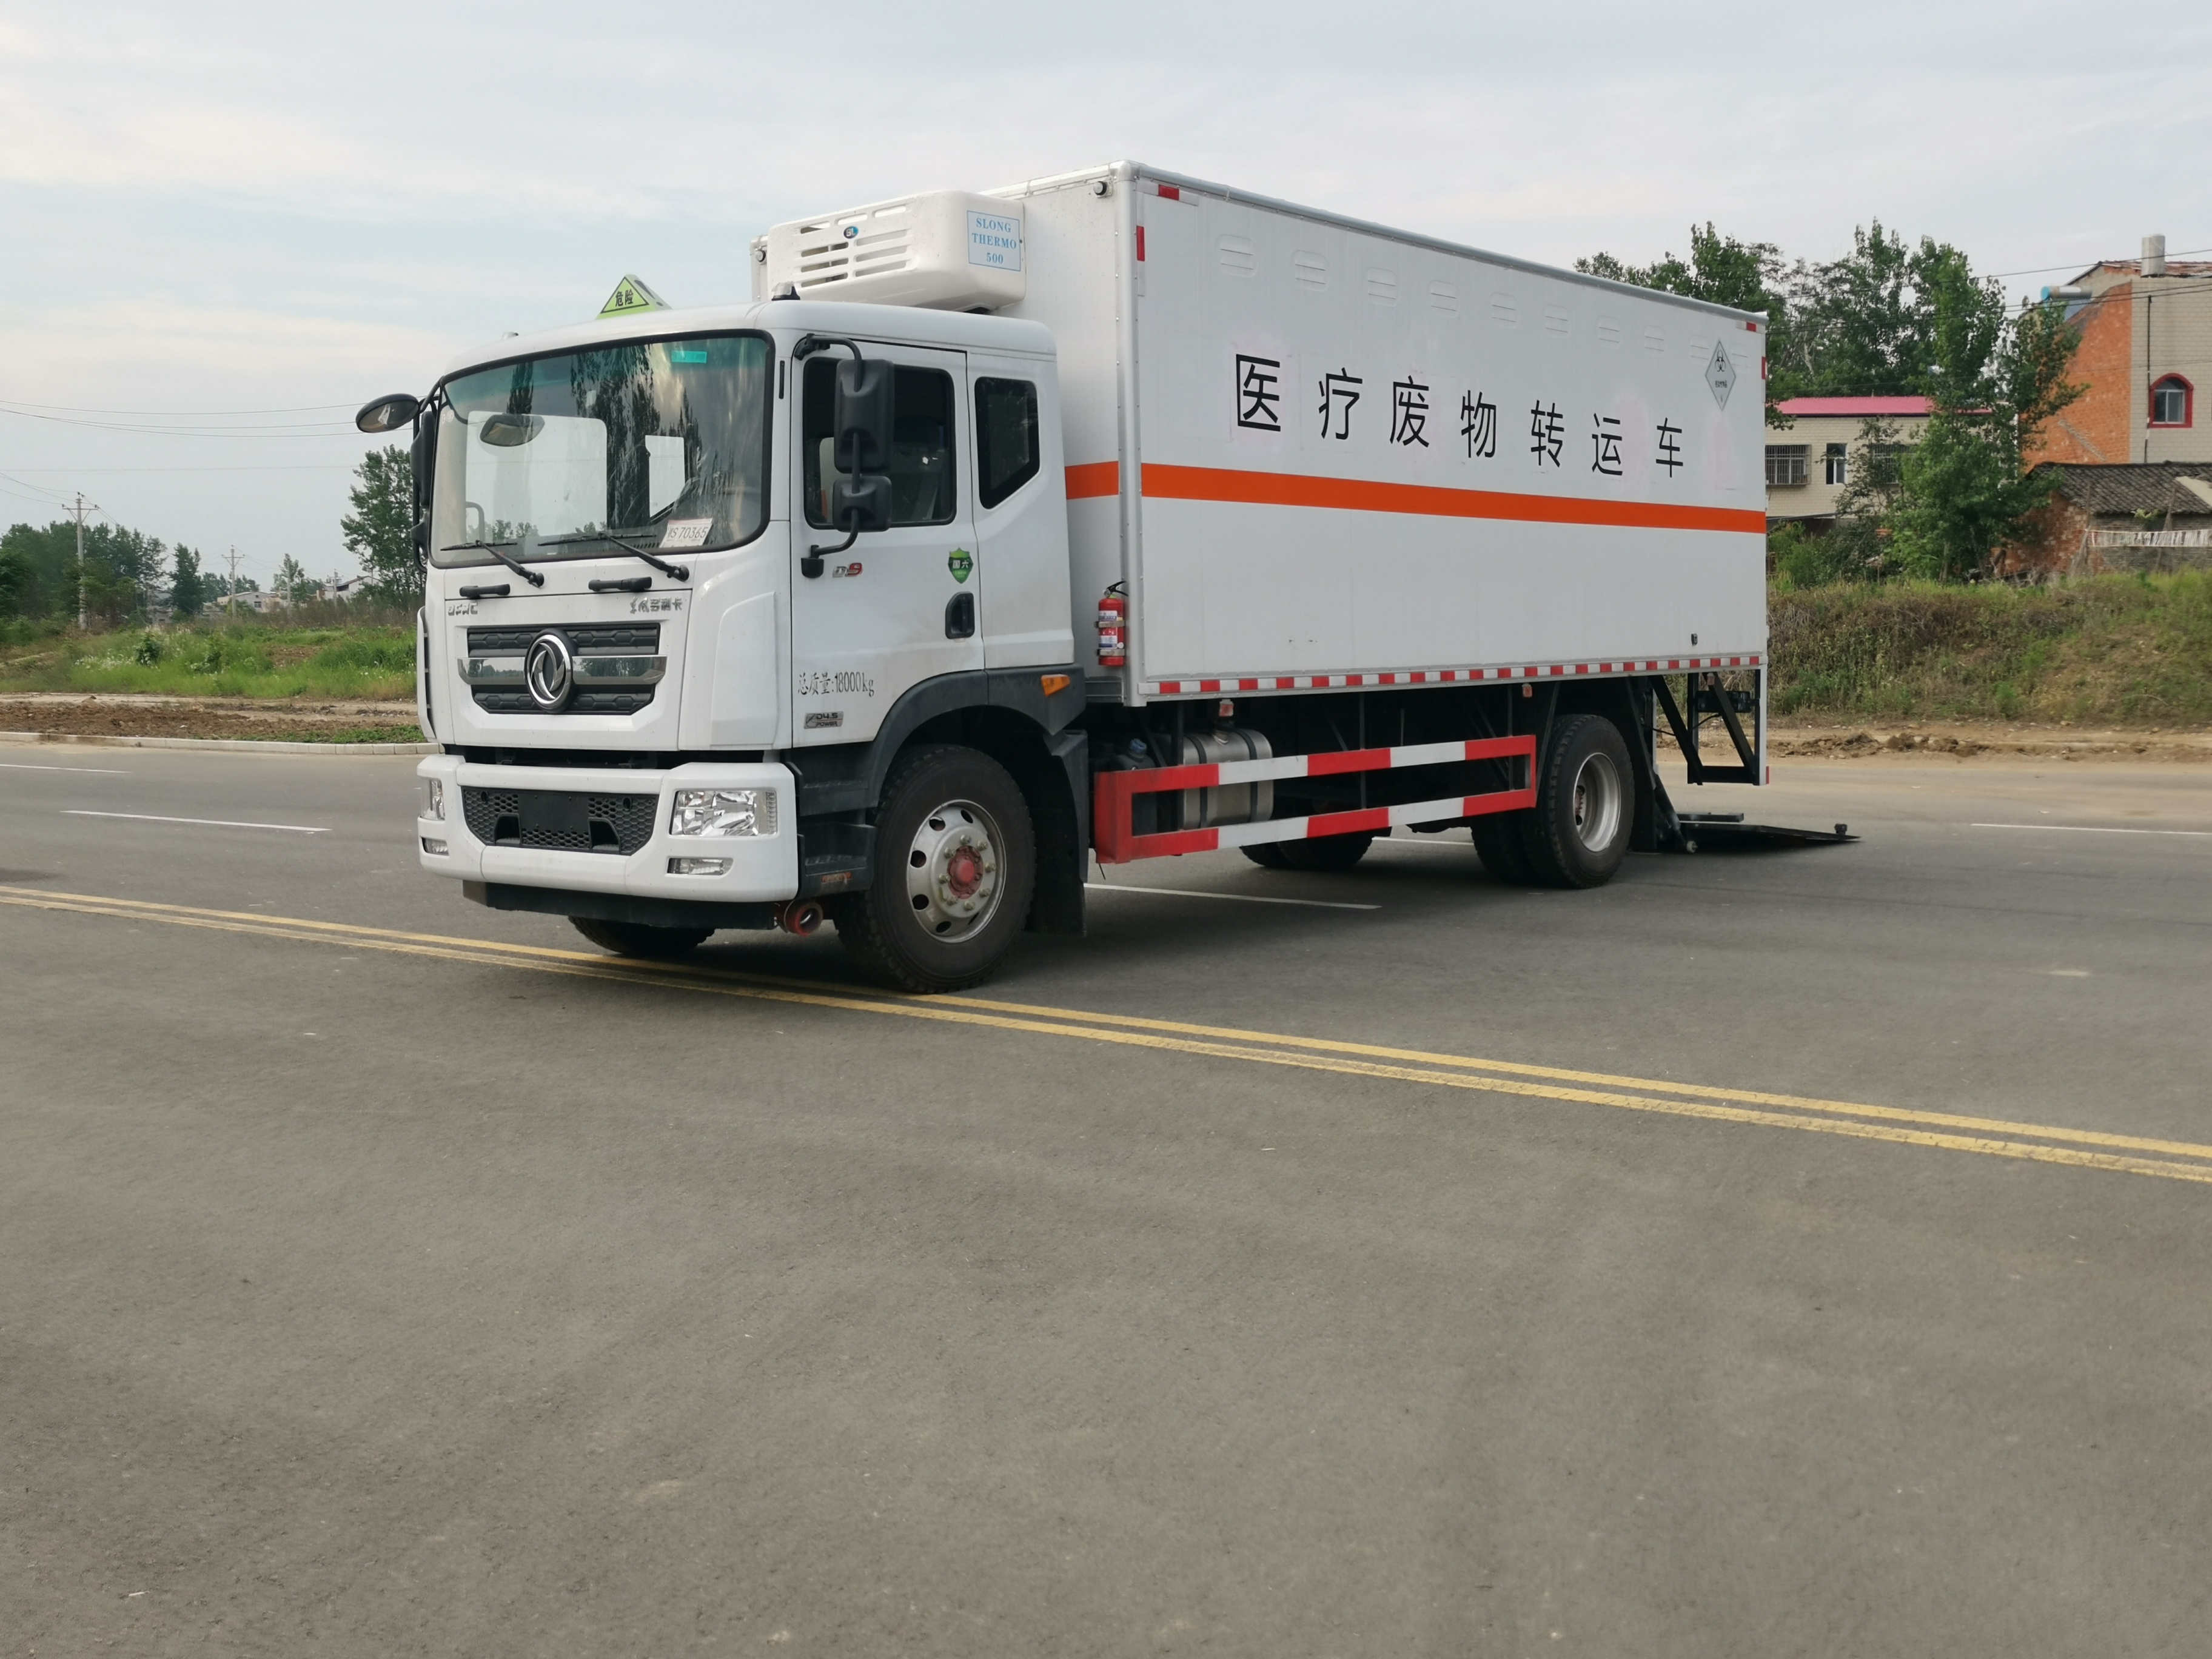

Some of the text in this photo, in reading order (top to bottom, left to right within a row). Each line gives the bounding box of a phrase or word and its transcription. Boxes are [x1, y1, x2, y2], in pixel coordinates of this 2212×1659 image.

[976, 218, 1011, 233] SLONG
[972, 232, 1016, 249] THERMO
[987, 252, 1004, 264] 500
[615, 289, 634, 307] 危险
[1236, 354, 1684, 478] 医疗废物转运车
[833, 563, 863, 578] D9
[953, 560, 970, 569] 国六
